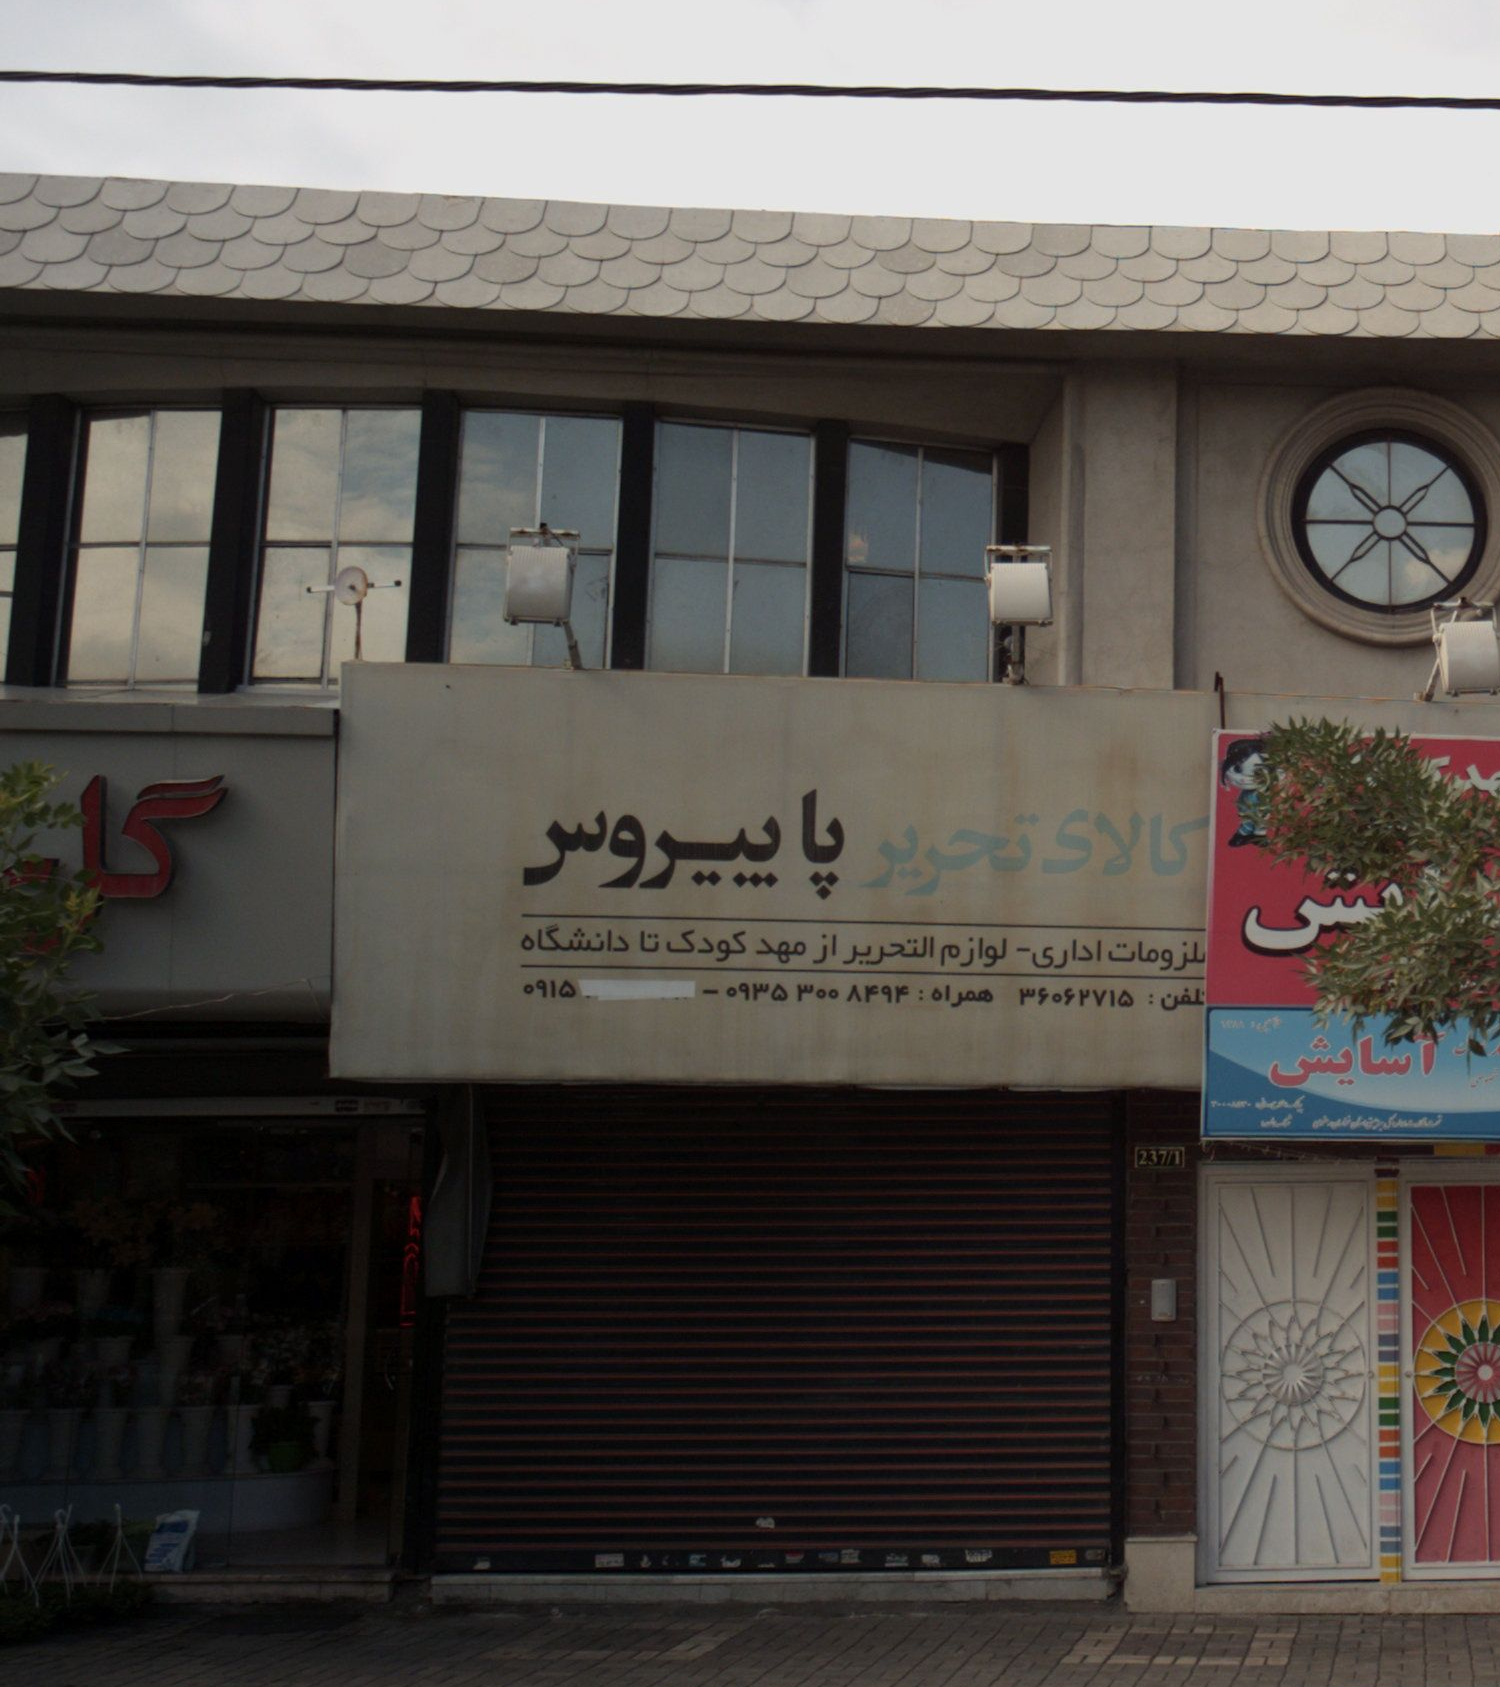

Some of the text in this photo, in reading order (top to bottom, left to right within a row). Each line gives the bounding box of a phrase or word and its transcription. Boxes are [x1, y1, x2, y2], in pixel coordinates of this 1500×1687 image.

[859, 813, 1040, 896] تحریر
[1042, 808, 1211, 876] کالای
[521, 924, 630, 952] دانشگاه
[640, 930, 660, 952] تا
[667, 929, 746, 961] کودک
[757, 937, 806, 963] مهد
[813, 934, 837, 963] از
[843, 935, 935, 965] التحریر
[941, 937, 1008, 966] لوازم
[726, 980, 789, 1001] ۰۹۳۵
[797, 981, 839, 1000] ۳۰۰
[847, 984, 909, 1004] ۸۴۹۴
[932, 985, 994, 1007] همراه
[1019, 987, 1134, 1007] ۳۶۰۶۲۷۱۵
[1270, 1031, 1446, 1088] آسایش
[1138, 1150, 1180, 1165] 237/1
